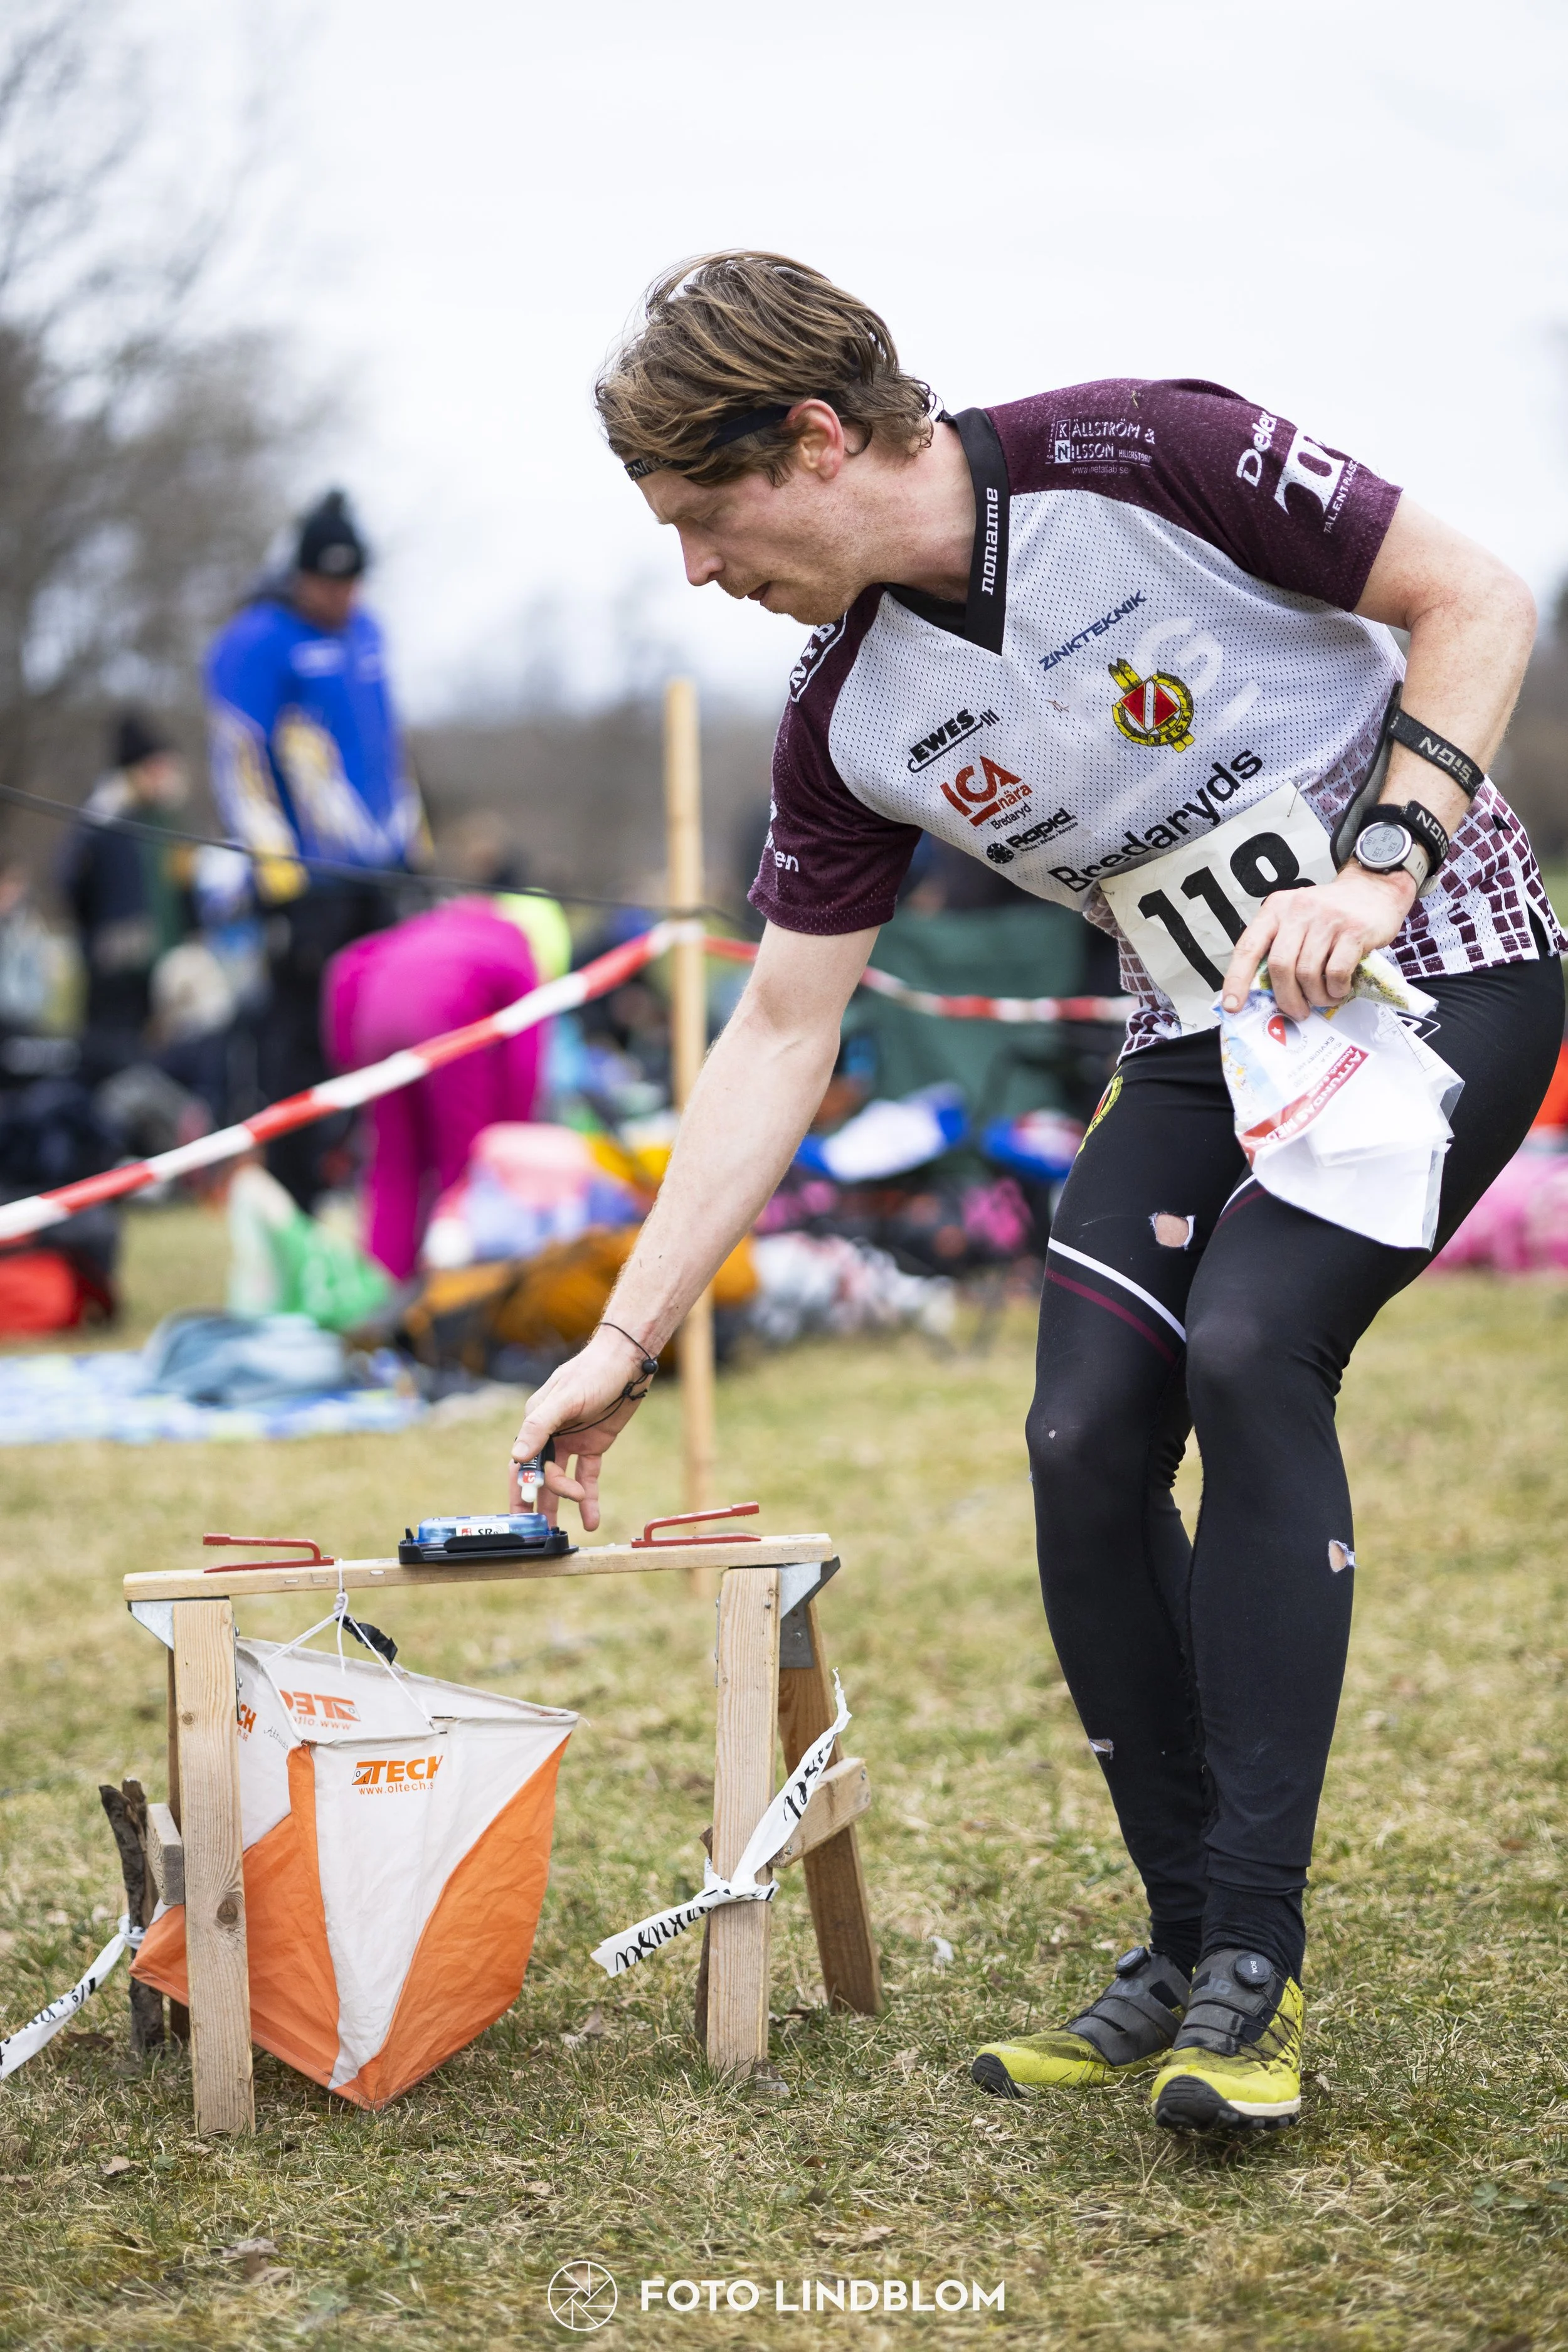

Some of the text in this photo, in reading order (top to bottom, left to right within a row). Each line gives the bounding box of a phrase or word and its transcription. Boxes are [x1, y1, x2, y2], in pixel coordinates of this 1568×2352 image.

[982, 487, 999, 595] noname
[1038, 589, 1147, 671] ZINKTEKNIK
[909, 709, 975, 763] EWES
[940, 755, 1022, 817] ICA
[999, 784, 1033, 811] nära
[990, 802, 1032, 830] Bredaryd
[1005, 807, 1074, 849] Rapid
[1047, 750, 1263, 893] Bredaryds
[359, 1781, 434, 1795] www.oltech.s
[1250, 1960, 1258, 1974] BOA
